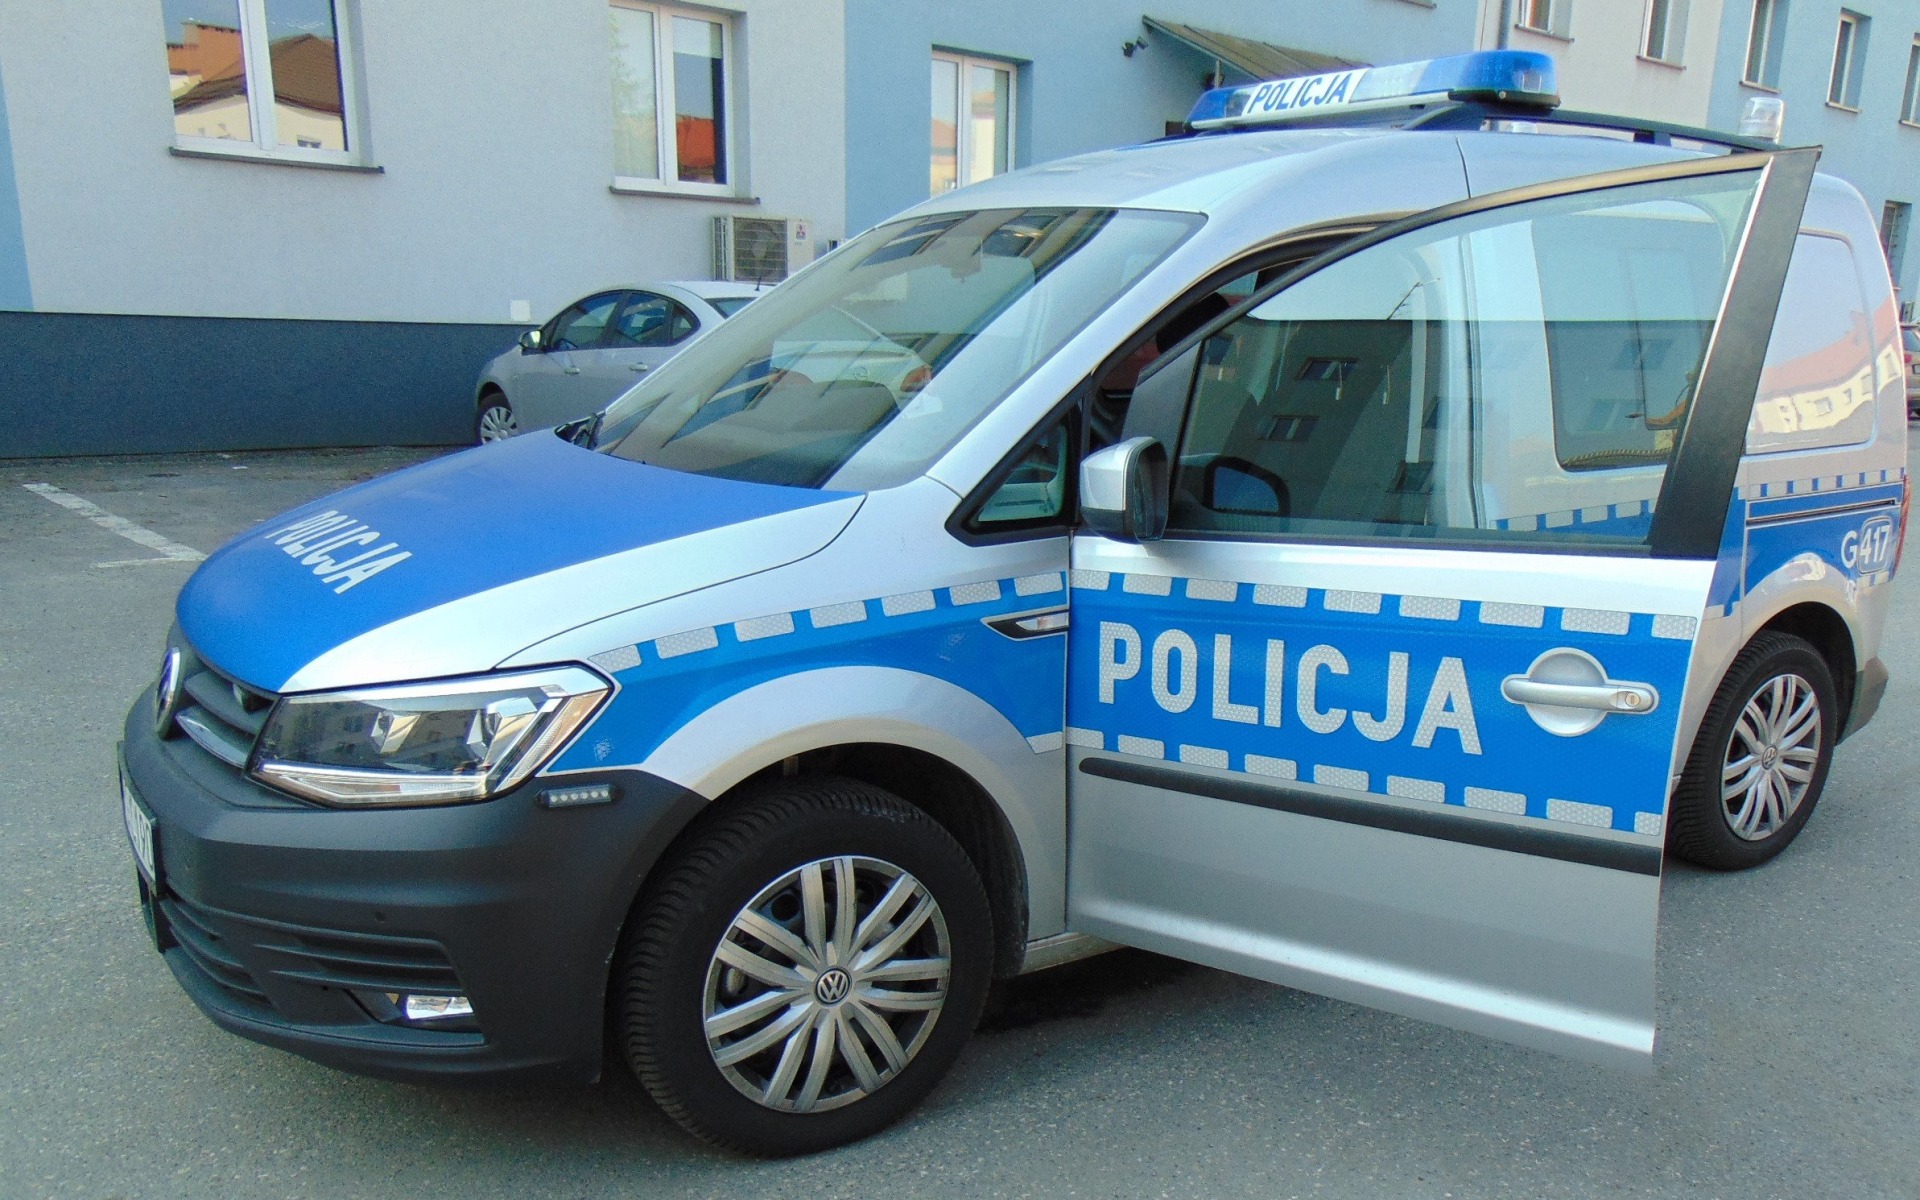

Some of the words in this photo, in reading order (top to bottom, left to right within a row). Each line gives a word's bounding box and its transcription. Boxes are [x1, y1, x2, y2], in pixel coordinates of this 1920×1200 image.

[1247, 73, 1352, 114] POLICJA
[265, 510, 413, 595] POLICJA
[1099, 621, 1483, 755] POLICJA
[818, 970, 849, 1002] VW
